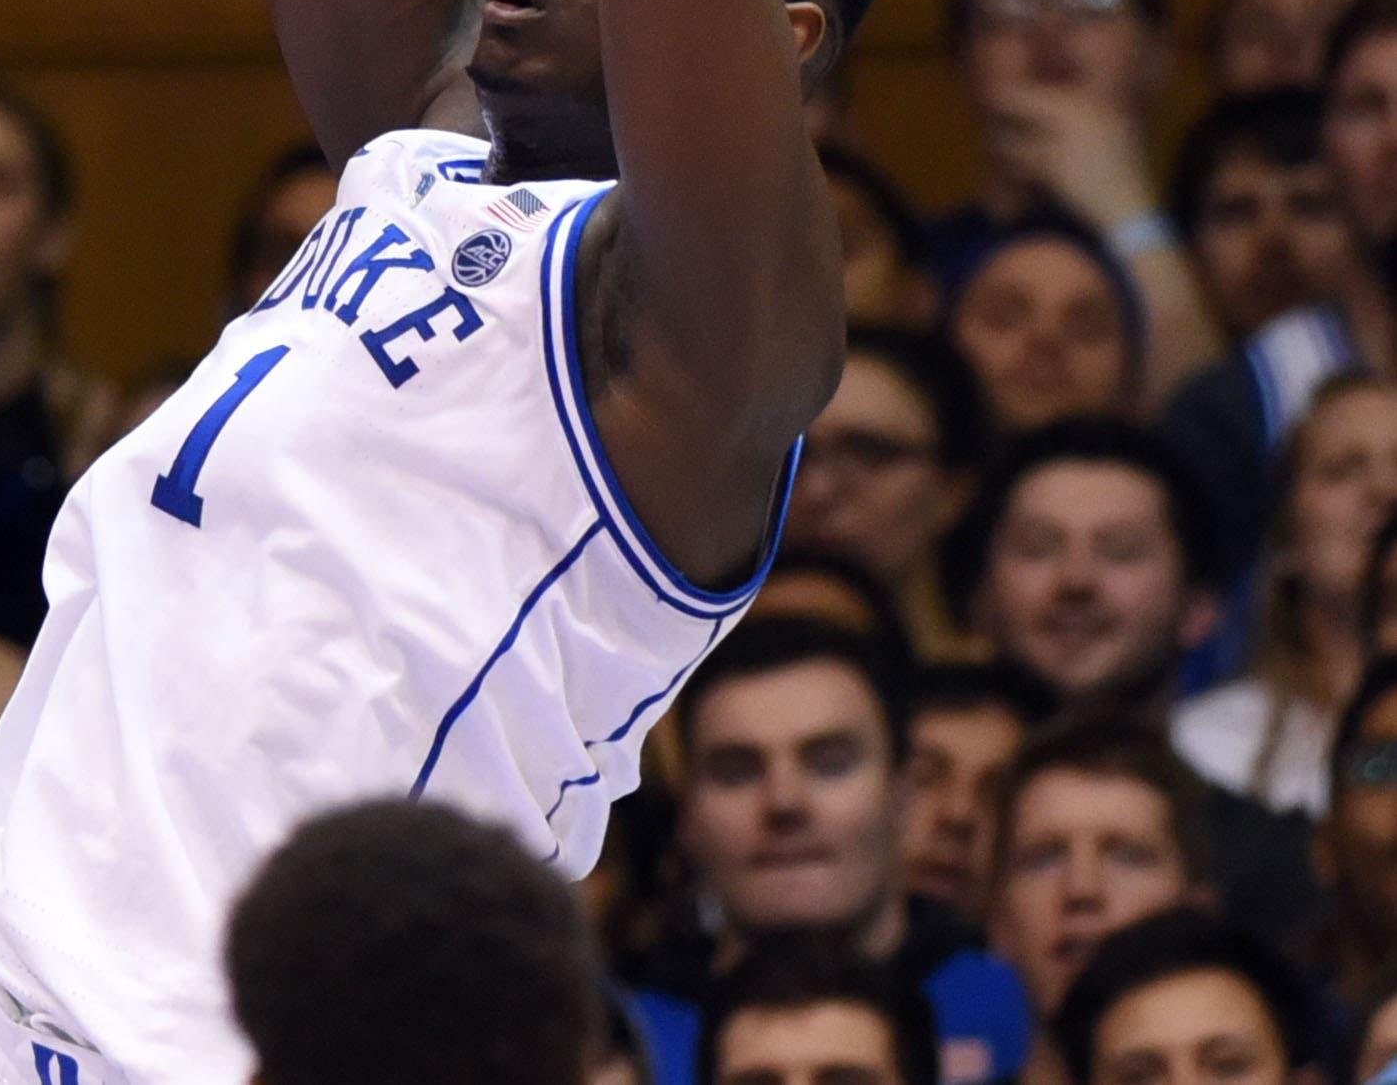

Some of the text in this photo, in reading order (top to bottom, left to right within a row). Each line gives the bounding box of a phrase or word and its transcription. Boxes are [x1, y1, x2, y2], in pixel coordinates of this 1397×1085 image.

[248, 207, 484, 390] DUKE
[463, 244, 506, 269] ACC
[151, 344, 291, 529] 1
